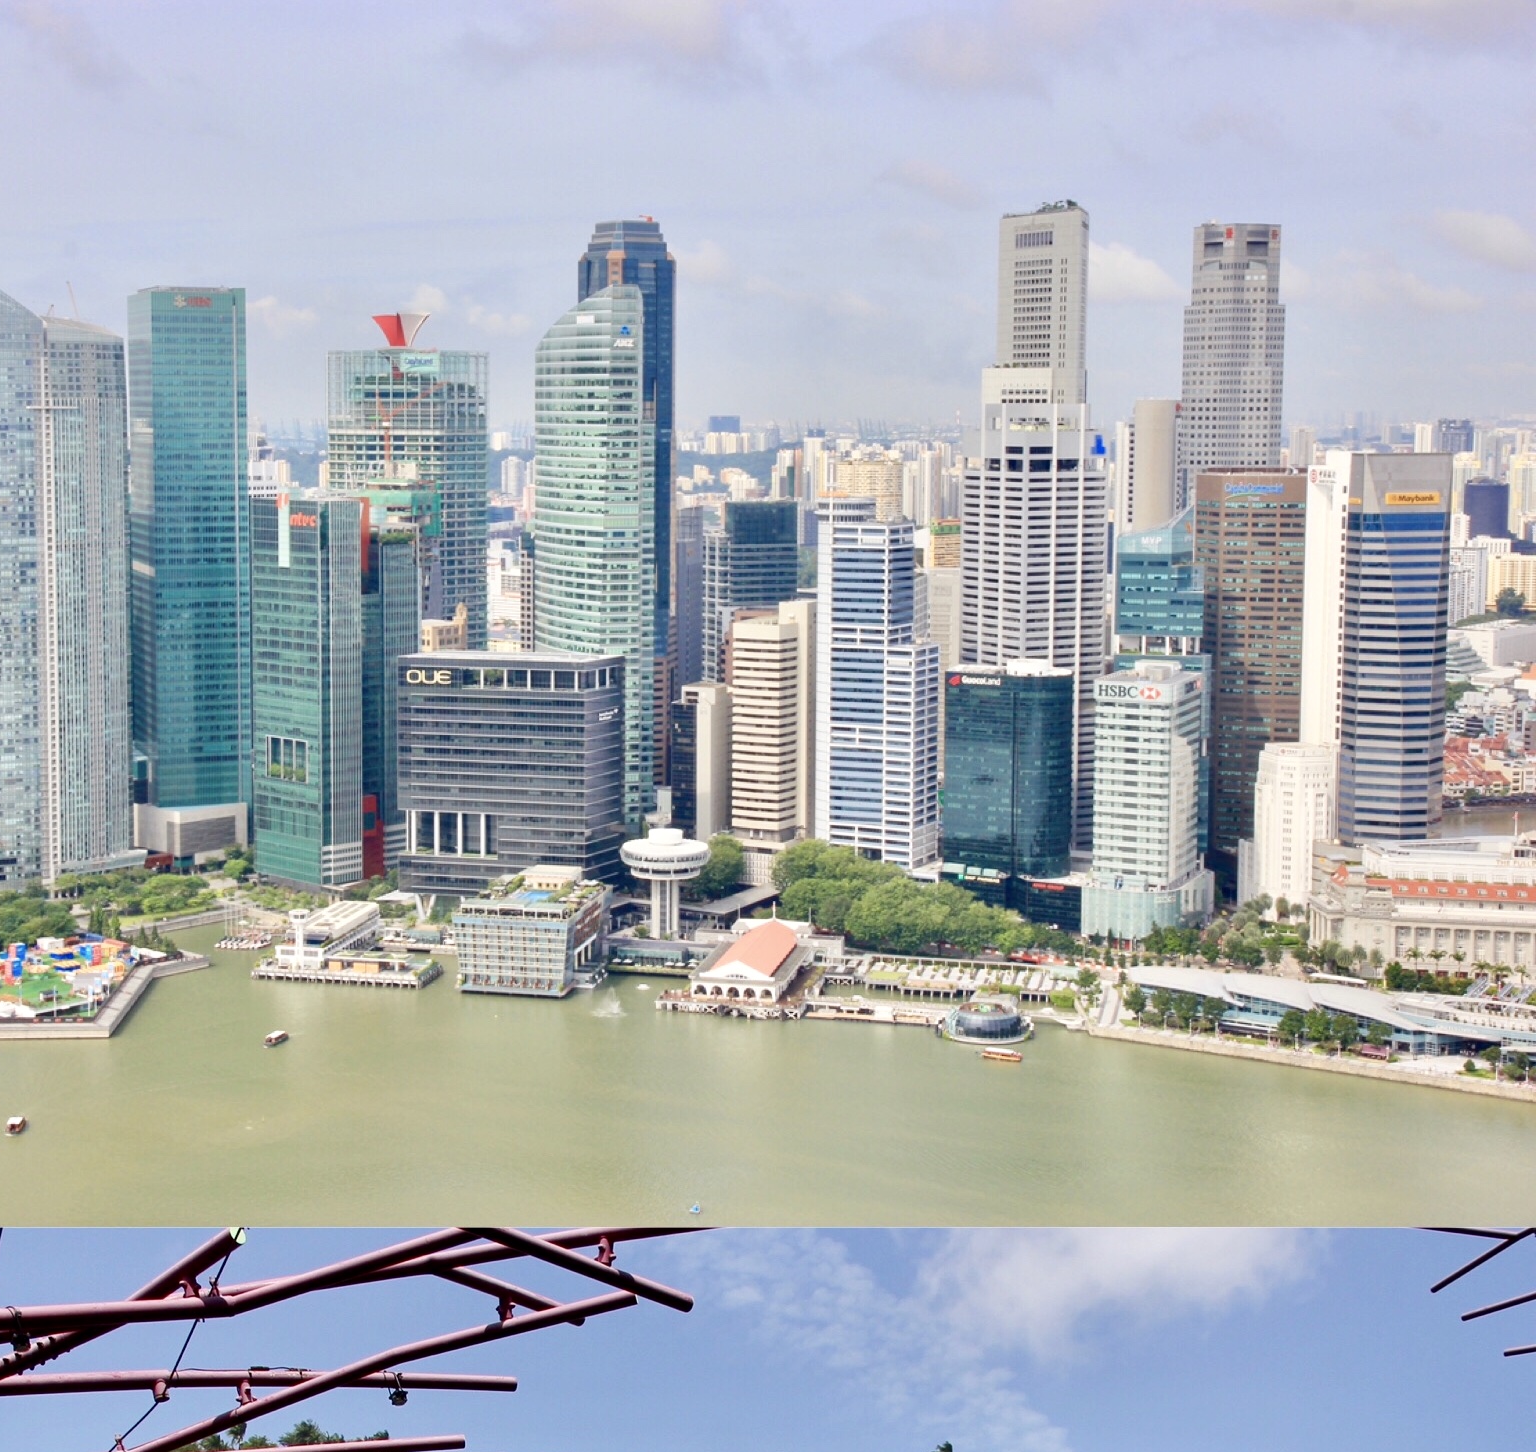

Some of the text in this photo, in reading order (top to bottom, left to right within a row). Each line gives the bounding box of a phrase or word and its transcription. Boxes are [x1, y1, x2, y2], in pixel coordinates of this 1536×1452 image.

[1398, 494, 1435, 504] Maybank
[406, 669, 452, 685] OUE
[1098, 684, 1138, 698] HSBC
